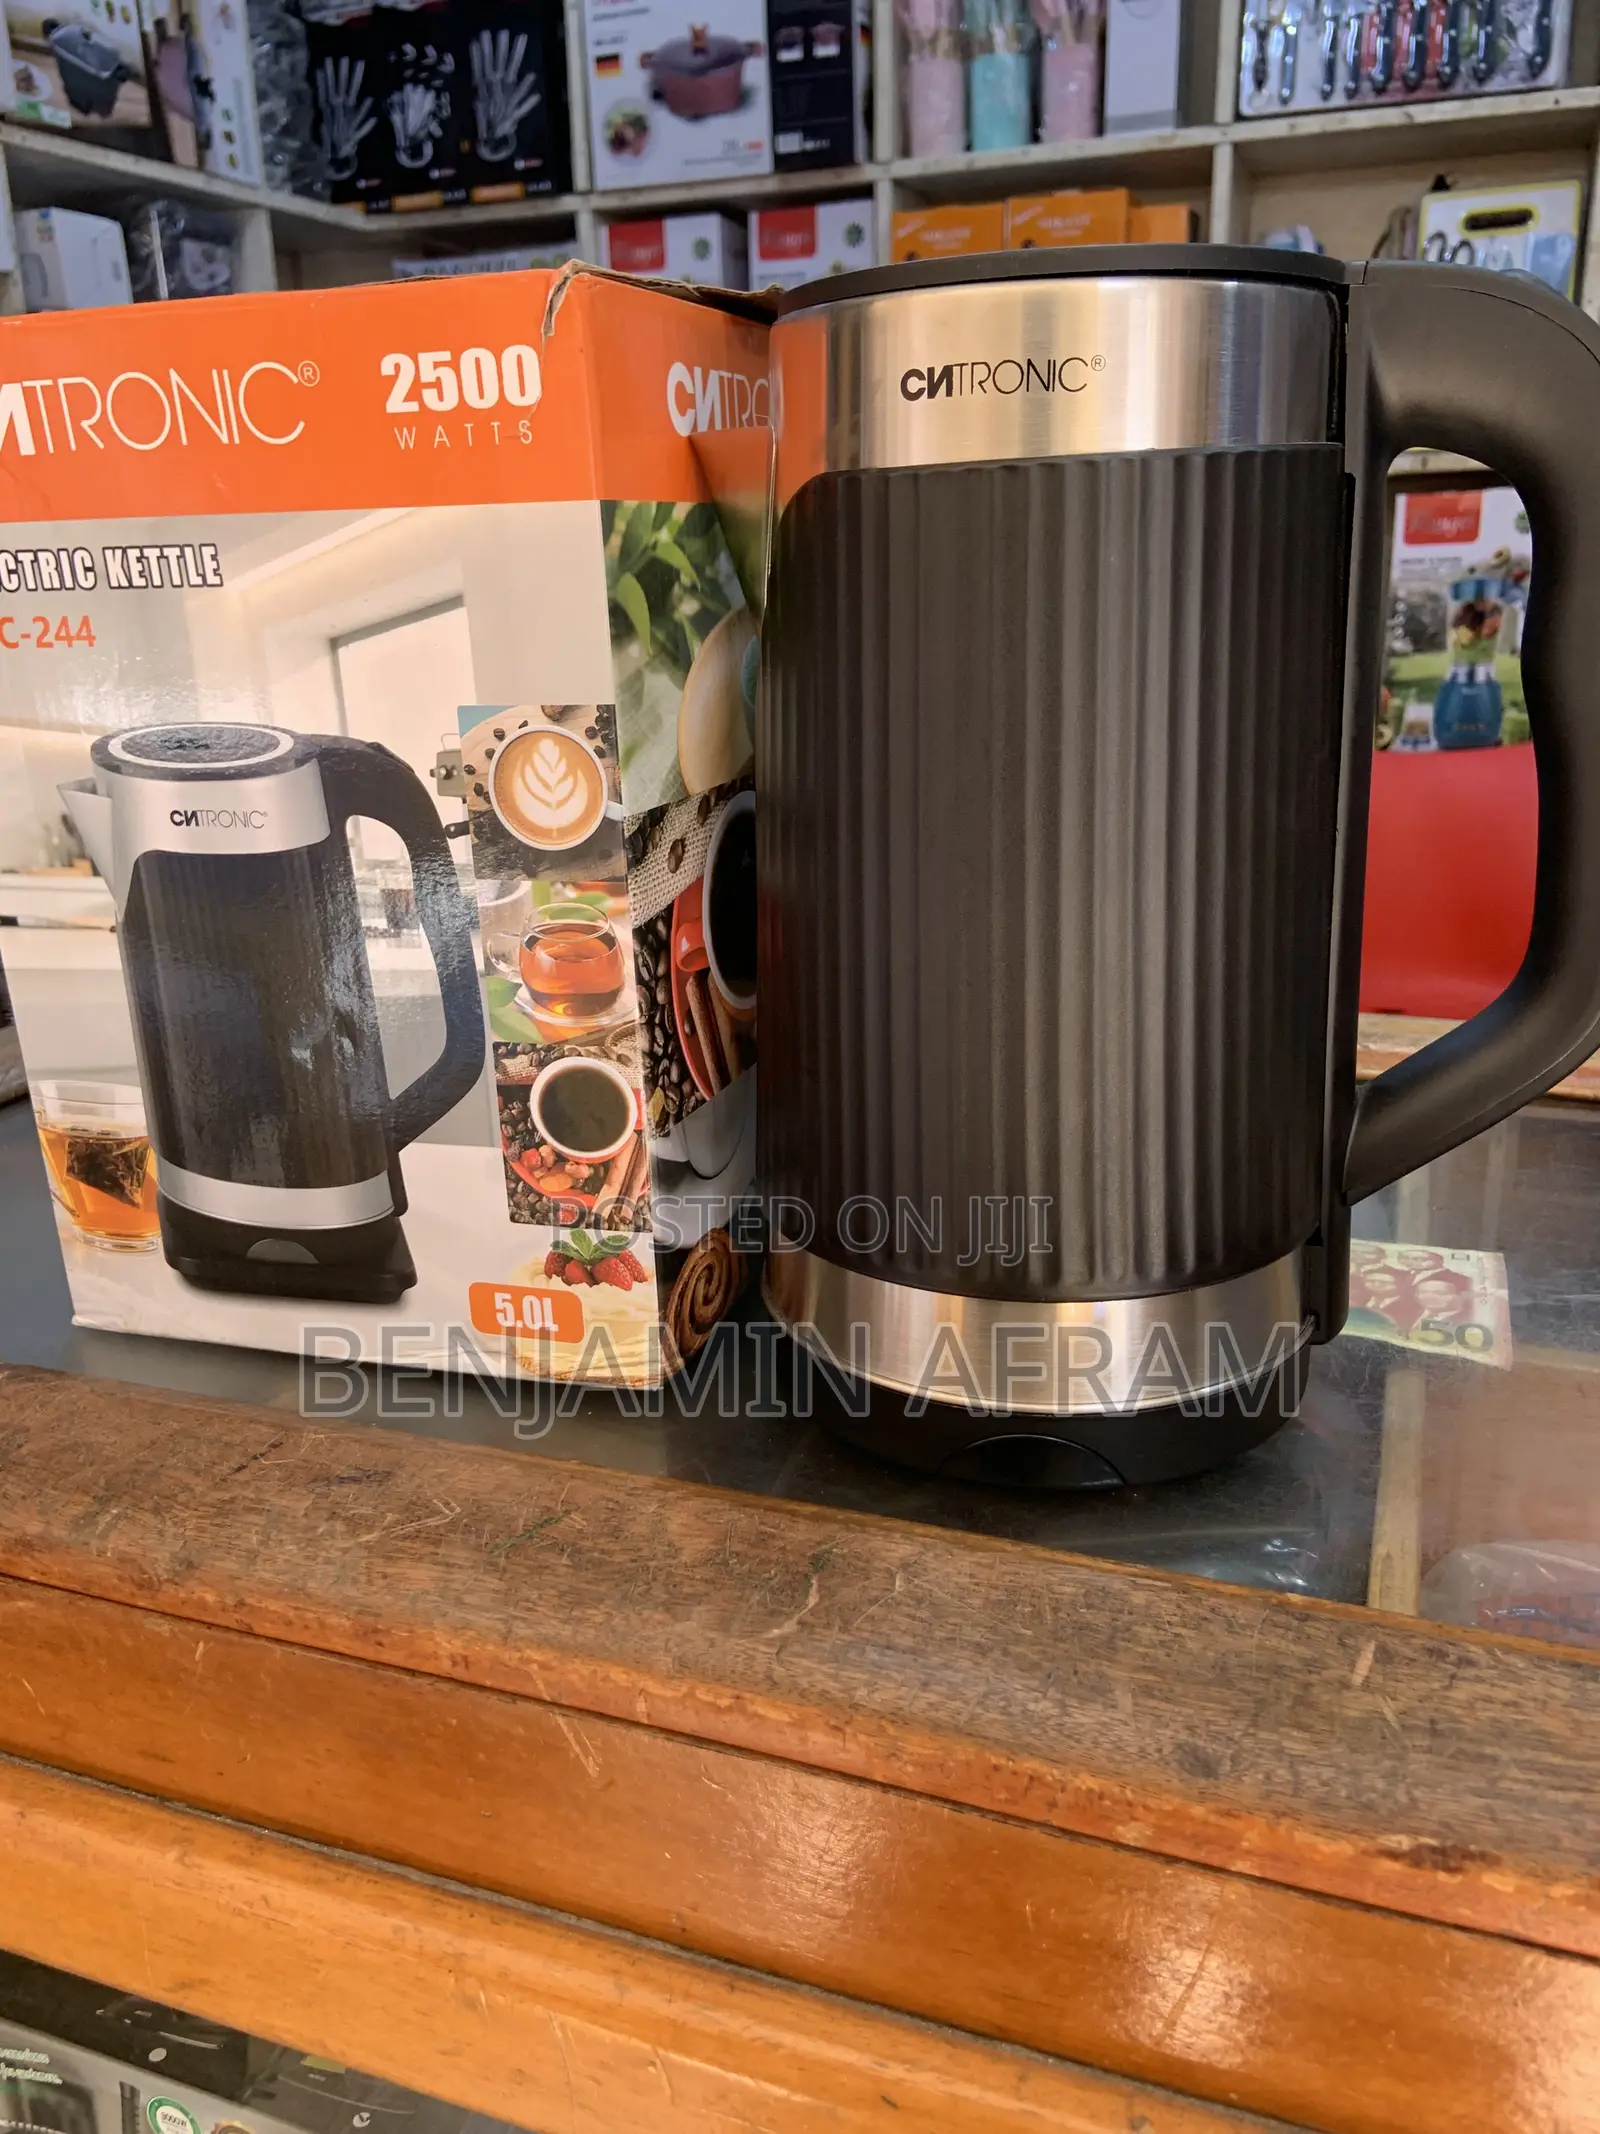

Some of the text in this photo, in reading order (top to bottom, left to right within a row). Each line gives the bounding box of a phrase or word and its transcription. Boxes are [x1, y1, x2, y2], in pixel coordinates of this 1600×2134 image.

[380, 344, 543, 414] 2500
[394, 420, 534, 450] WATTS
[0, 543, 224, 592] CTRIC KETTLE
[494, 1291, 559, 1332] 5.0L
[1410, 1318, 1494, 1351] 50
